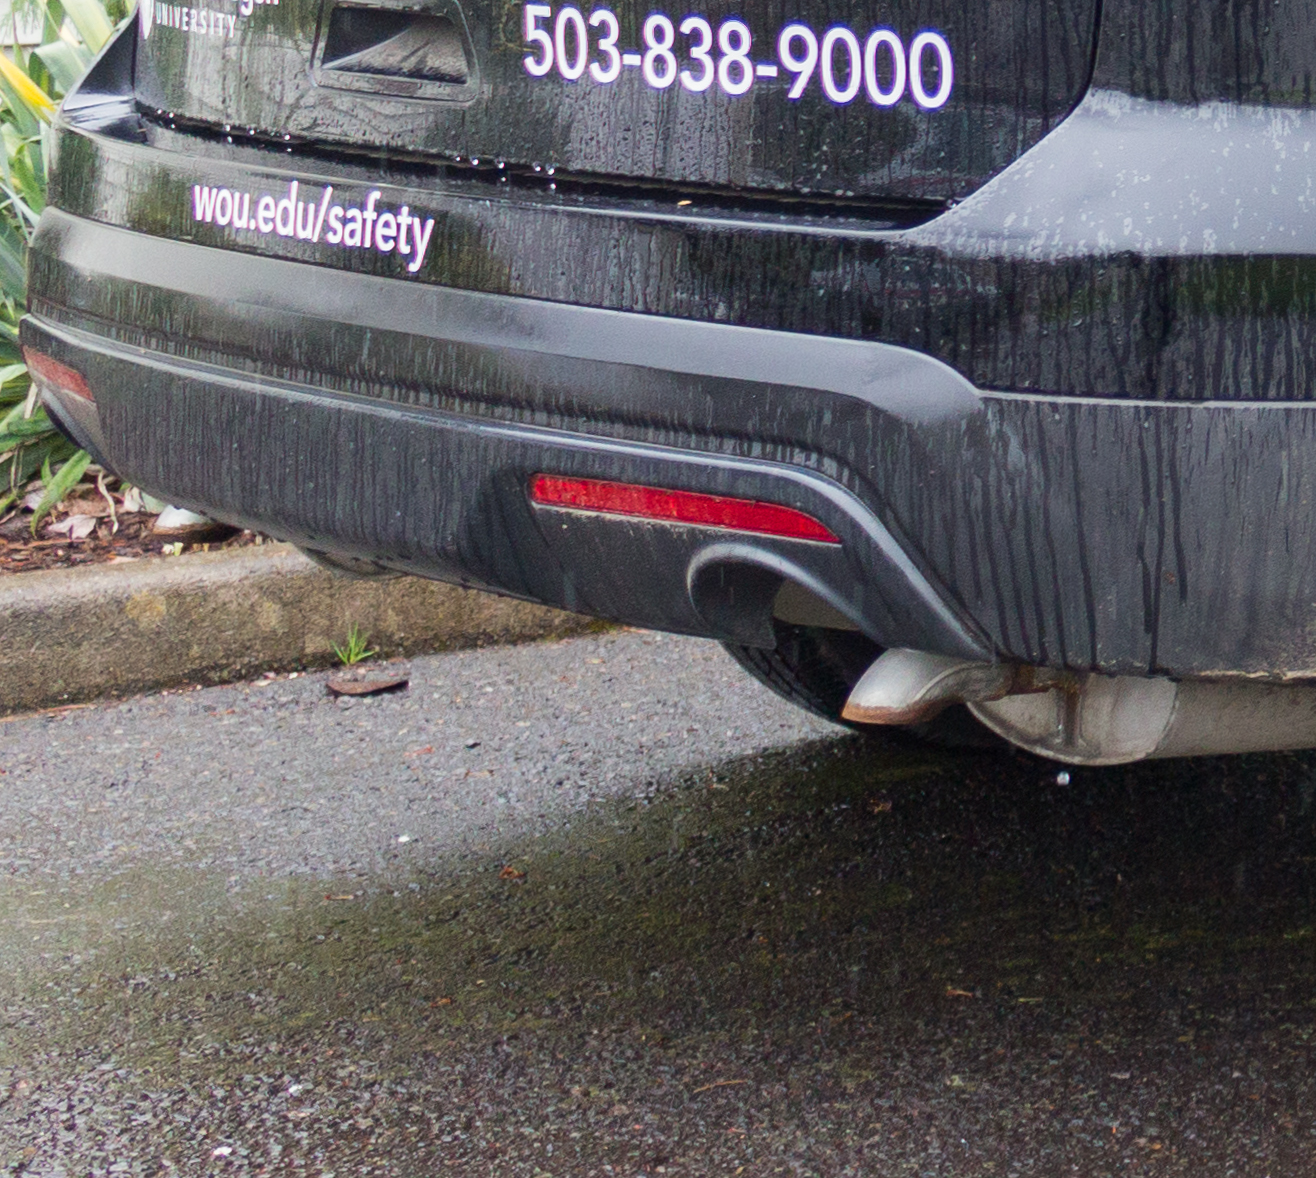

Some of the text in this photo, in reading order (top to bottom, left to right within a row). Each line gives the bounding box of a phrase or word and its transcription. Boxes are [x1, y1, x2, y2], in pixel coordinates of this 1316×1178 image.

[154, 1, 236, 39] UNIVERSITY
[522, 3, 956, 110] 503-838-9000
[192, 179, 436, 274] wou.edu/safety
